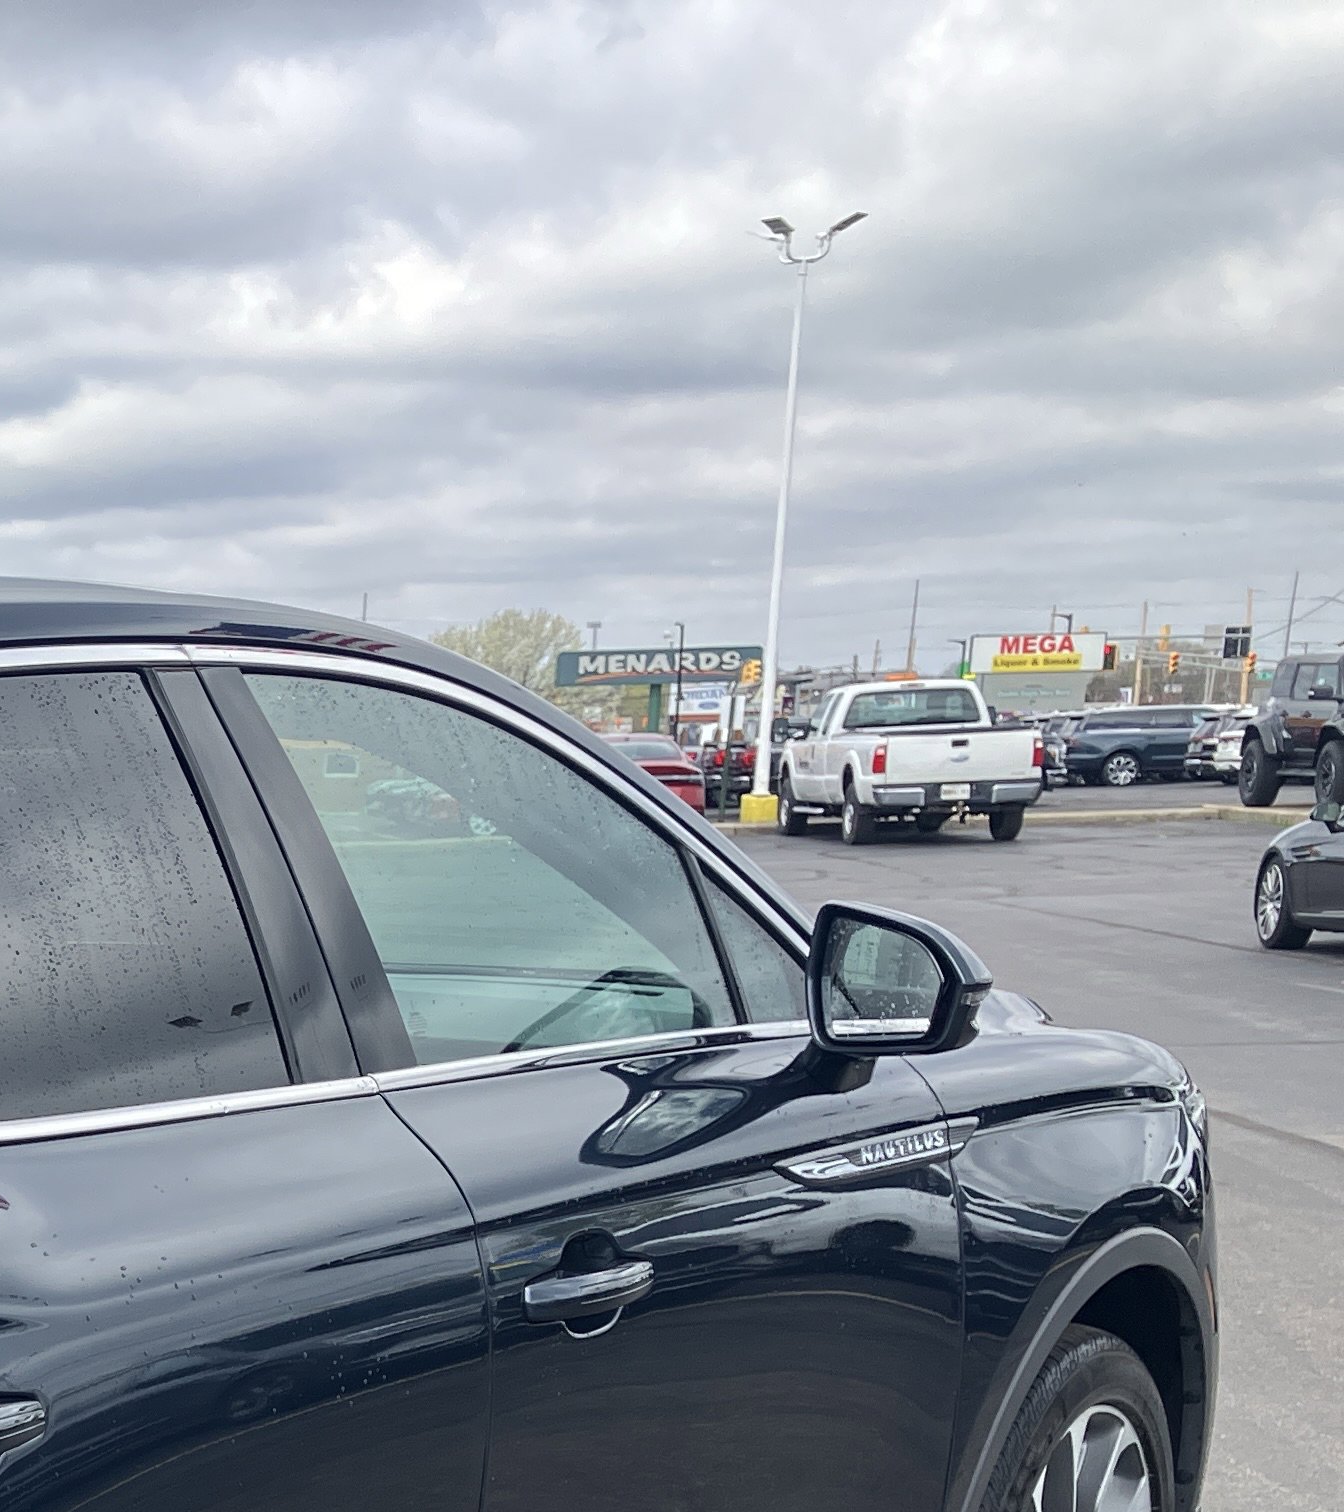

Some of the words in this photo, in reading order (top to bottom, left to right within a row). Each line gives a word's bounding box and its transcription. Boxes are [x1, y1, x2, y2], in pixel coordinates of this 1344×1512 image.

[1000, 633, 1074, 655] MEGA
[578, 650, 742, 674] MENARDS
[860, 1129, 945, 1165] NAUTILUS
